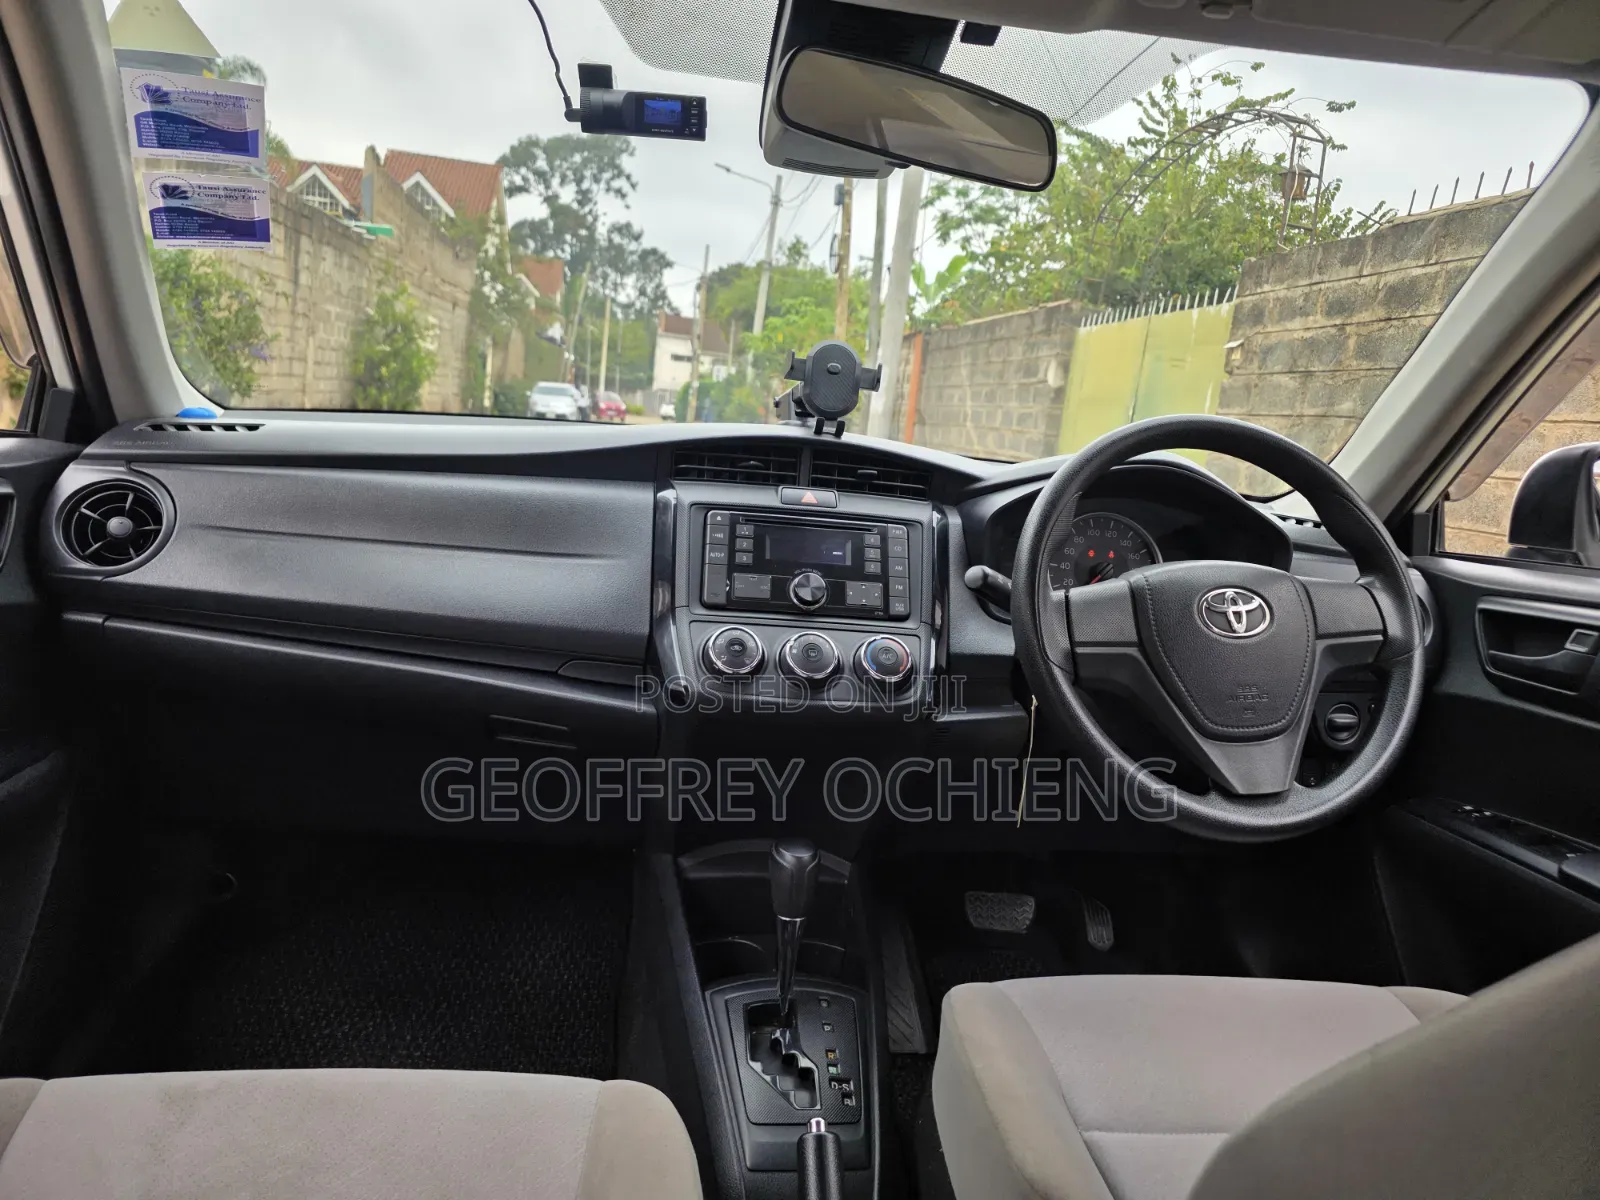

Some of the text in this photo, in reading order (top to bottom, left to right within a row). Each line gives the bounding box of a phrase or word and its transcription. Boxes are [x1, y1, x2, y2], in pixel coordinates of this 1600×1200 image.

[181, 86, 262, 103] Tausi Assurance
[182, 95, 229, 107] Company
[222, 186, 267, 195] Assurance
[197, 191, 239, 201] Company
[1087, 529, 1101, 537] 100
[1105, 530, 1118, 538] 120
[1064, 547, 1075, 555] 60
[1062, 578, 1074, 586] 20
